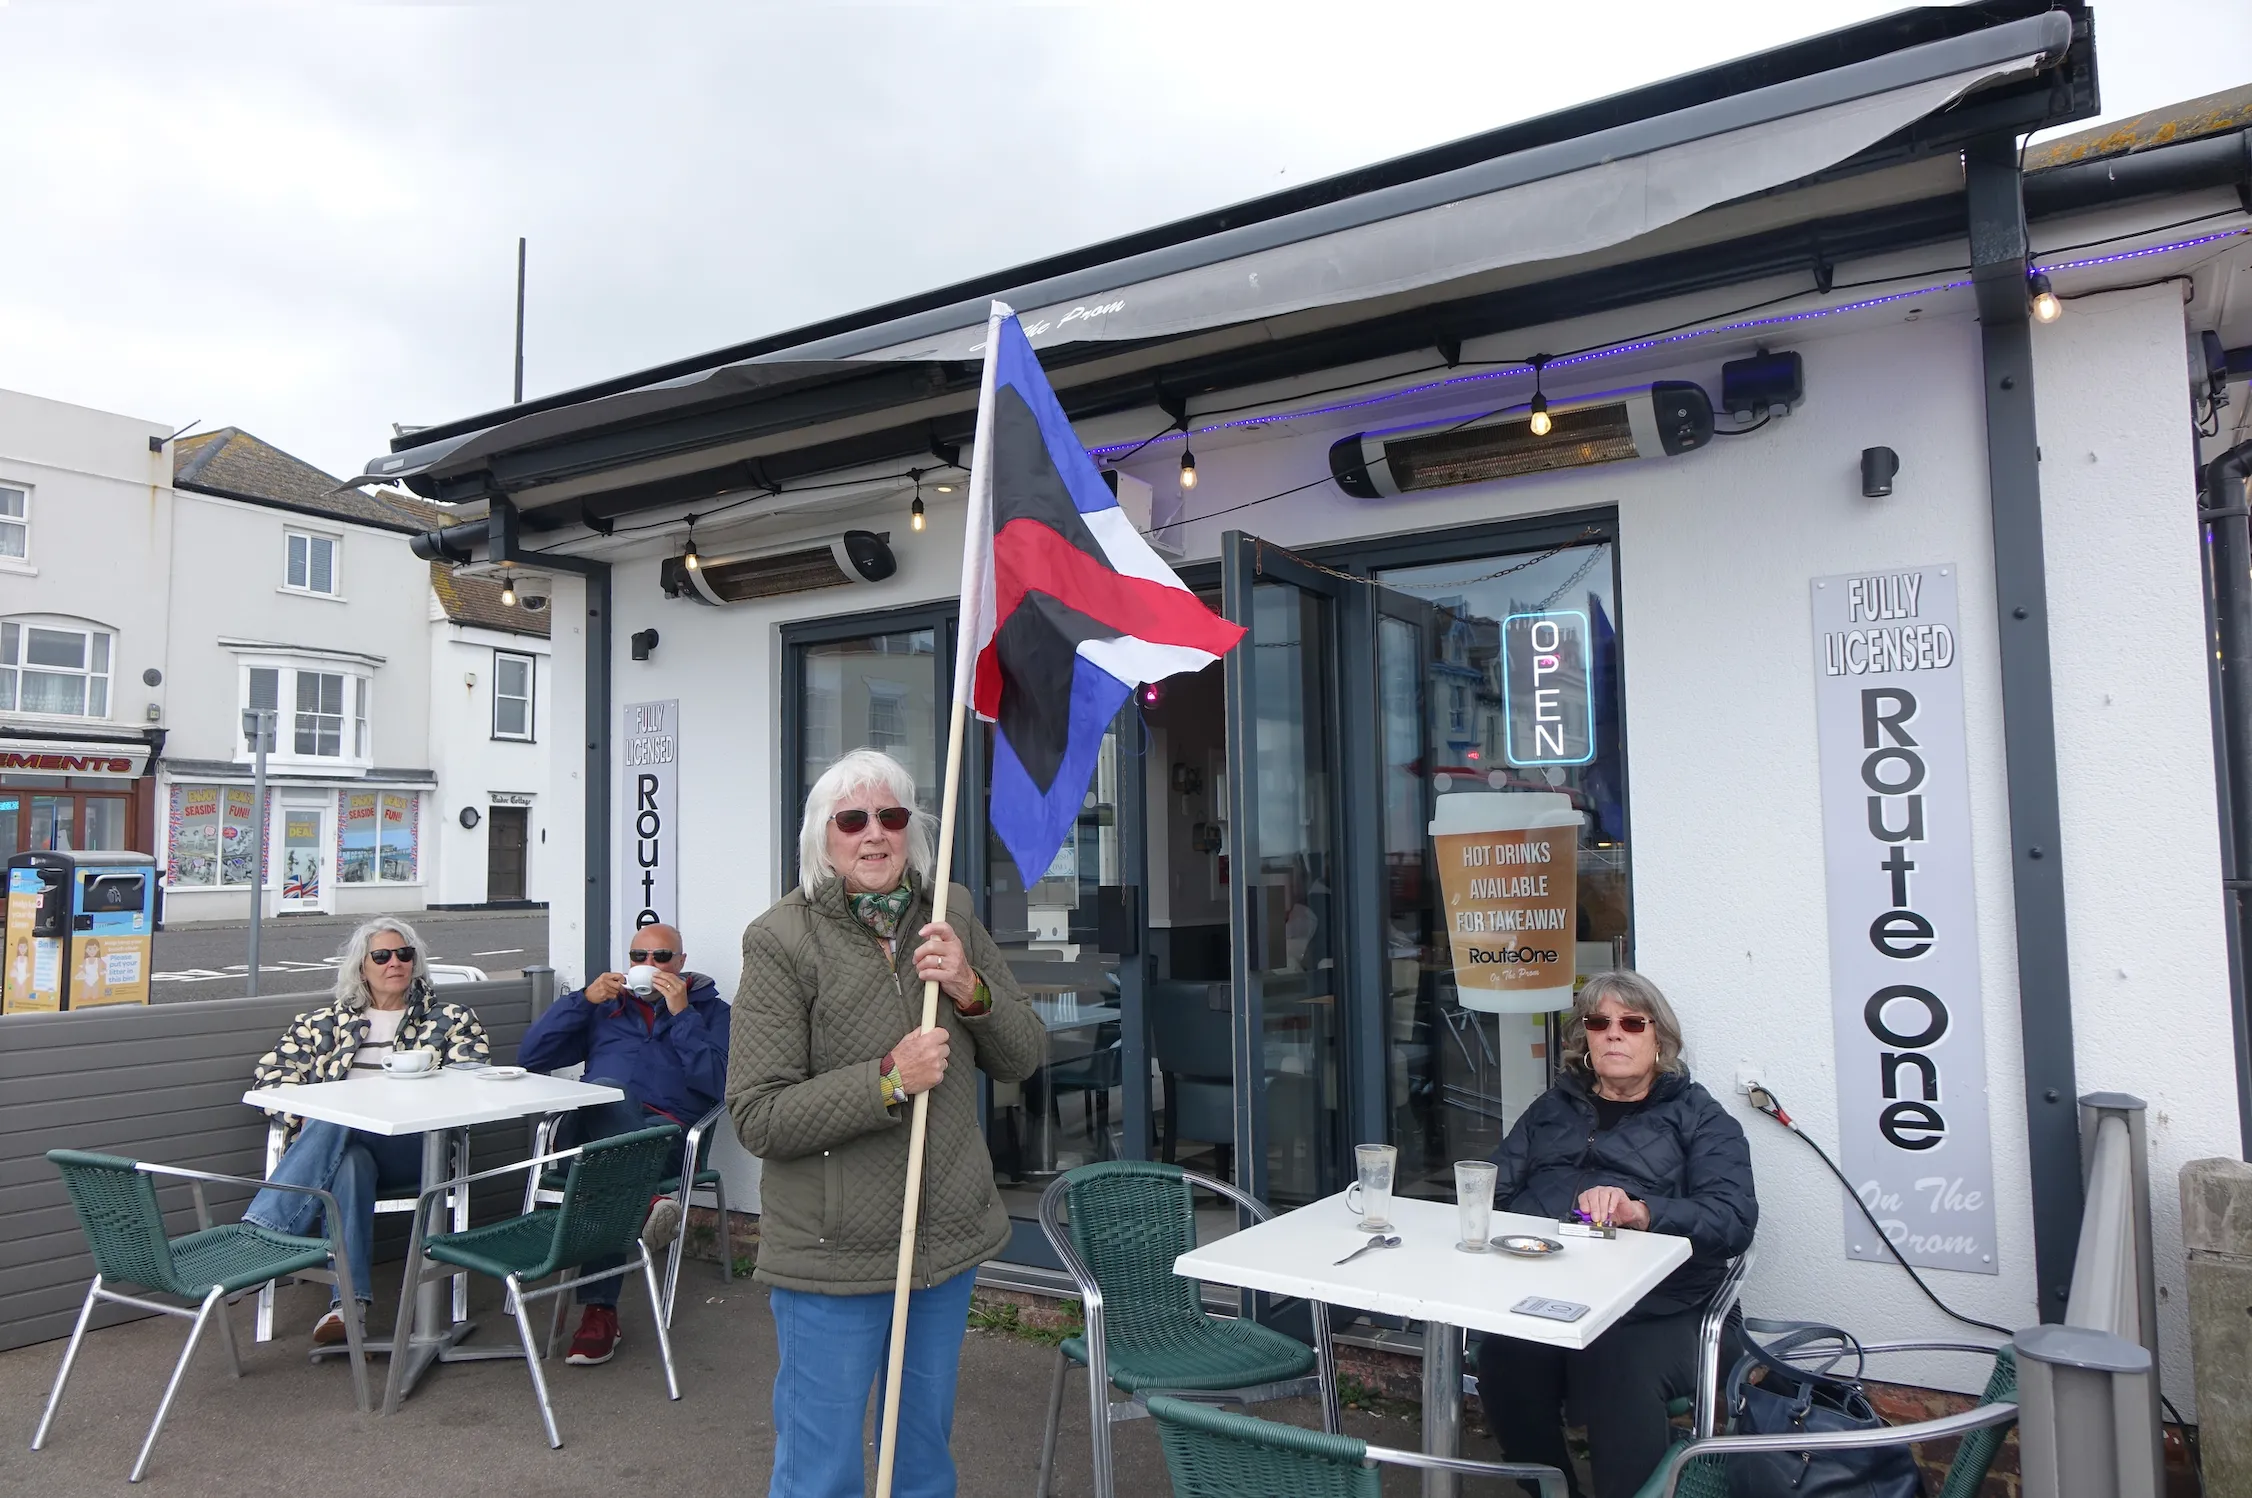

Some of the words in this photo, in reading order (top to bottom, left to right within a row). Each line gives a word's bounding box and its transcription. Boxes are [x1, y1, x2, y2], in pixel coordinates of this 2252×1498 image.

[1057, 300, 1125, 328] Prom
[1848, 572, 1922, 622] FULLY
[1824, 624, 1955, 676] LICENSED
[1531, 620, 1564, 756] OPEN
[635, 704, 665, 734] FULLY
[626, 735, 675, 766] LICENSED
[185, 804, 217, 816] SEASIDE
[348, 808, 374, 820] SEASIDE
[1860, 687, 1937, 960] Route
[288, 827, 316, 838] DEAL
[1463, 846, 1492, 867] HOT
[1495, 842, 1551, 865] DRINKS
[1470, 876, 1549, 899] AVAILABLE
[1456, 911, 1485, 932] FOR
[1488, 909, 1567, 931] TAKEAWAY
[1469, 946, 1559, 964] RouteOne
[1519, 968, 1541, 978] Prom
[1863, 984, 1950, 1151] One
[1856, 1180, 1904, 1212] On
[1914, 1176, 1984, 1213] The
[1875, 1219, 1979, 1256] Prom
